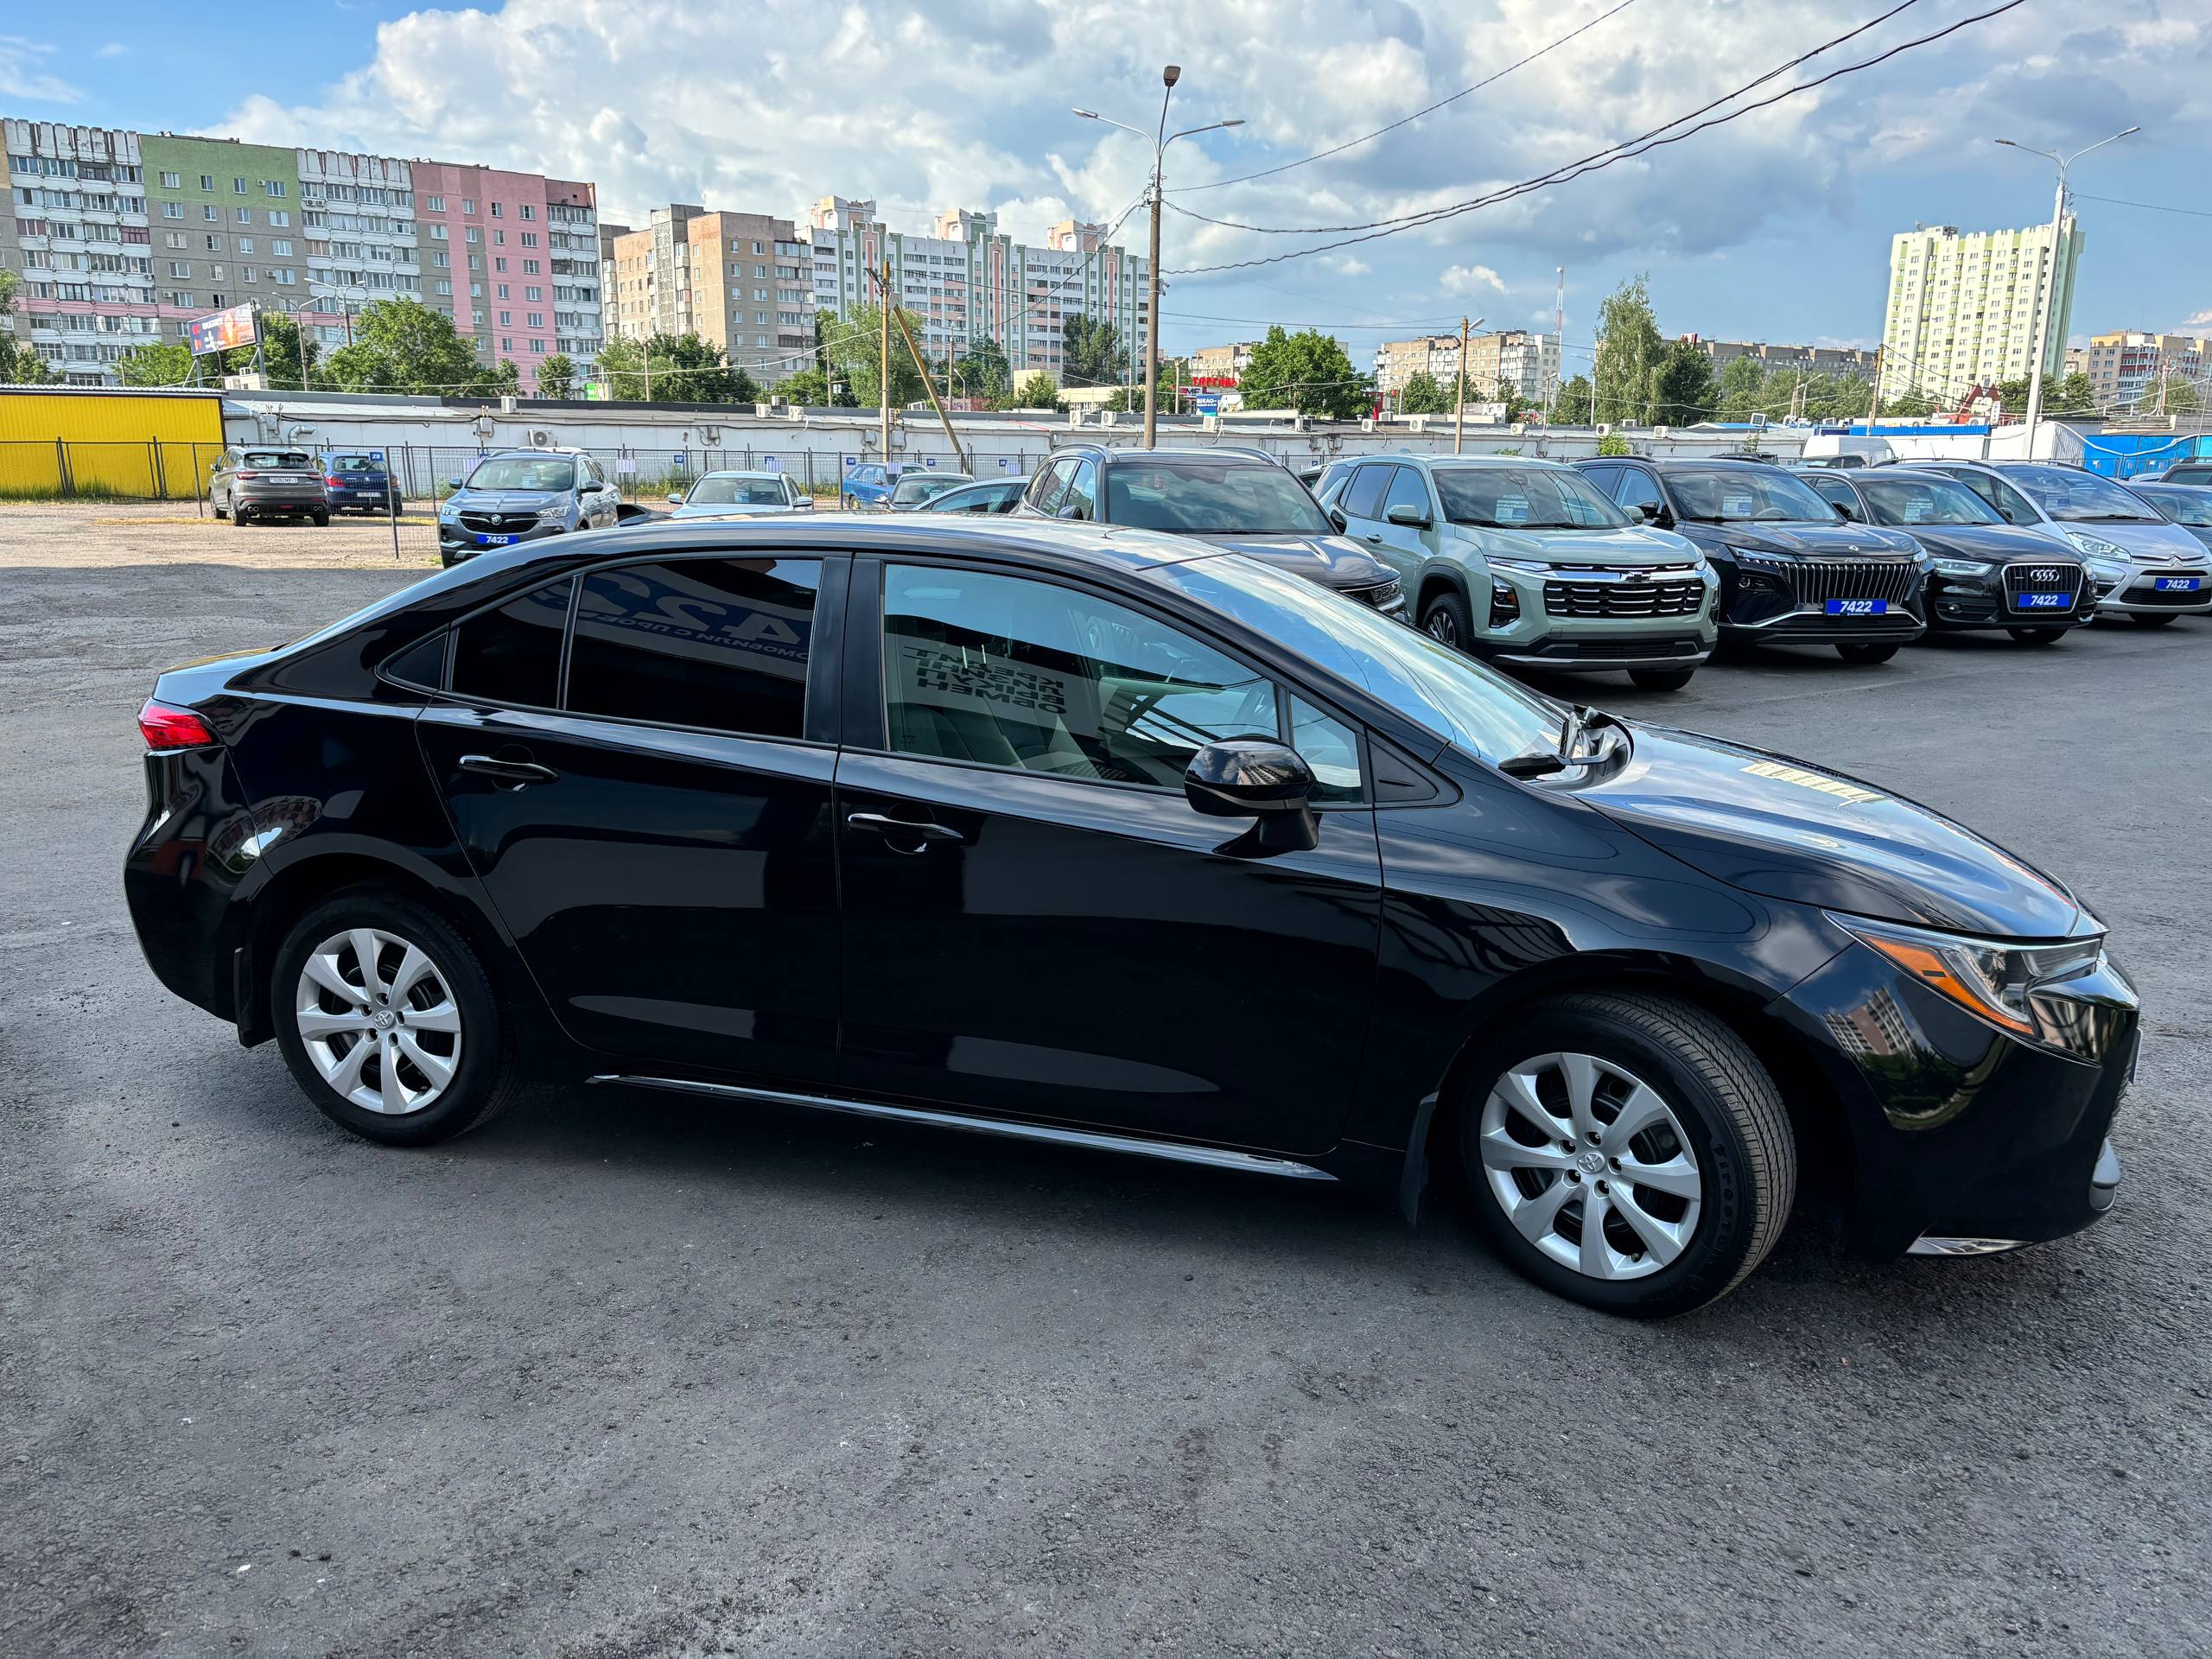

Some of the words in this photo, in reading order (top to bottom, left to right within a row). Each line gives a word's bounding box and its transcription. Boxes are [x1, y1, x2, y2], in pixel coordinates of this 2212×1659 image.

[486, 536, 509, 544] 7422
[2164, 580, 2190, 589] 7422
[2031, 594, 2059, 606] 7422
[1839, 601, 1873, 613] 7422
